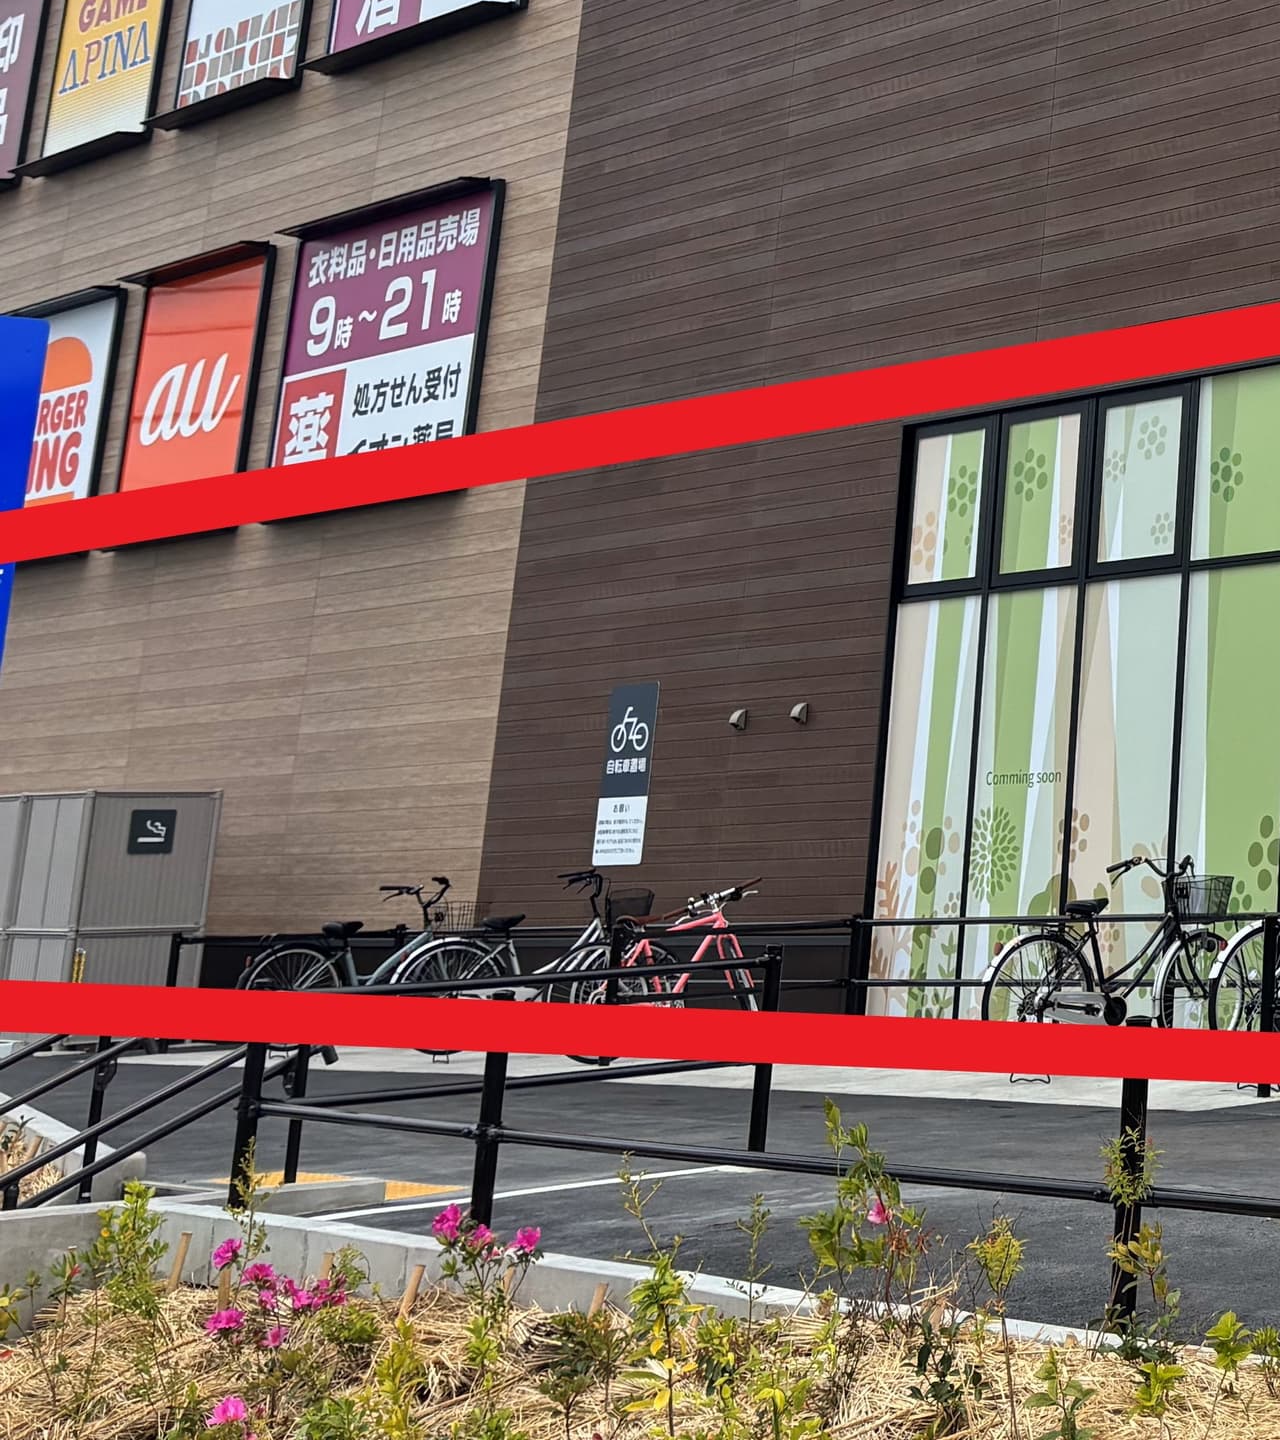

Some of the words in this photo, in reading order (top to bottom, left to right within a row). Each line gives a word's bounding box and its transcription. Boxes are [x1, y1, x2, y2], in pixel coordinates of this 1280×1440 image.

[0, 13, 25, 73] 印
[307, 207, 481, 289] 衣料品・日用品売場
[37, 390, 89, 437] RGER
[139, 352, 241, 447] au
[351, 361, 462, 418] 処方せん受付
[283, 391, 335, 466] 薬
[27, 430, 82, 495] ING
[986, 768, 1035, 789] Comming
[1036, 771, 1062, 784] soon
